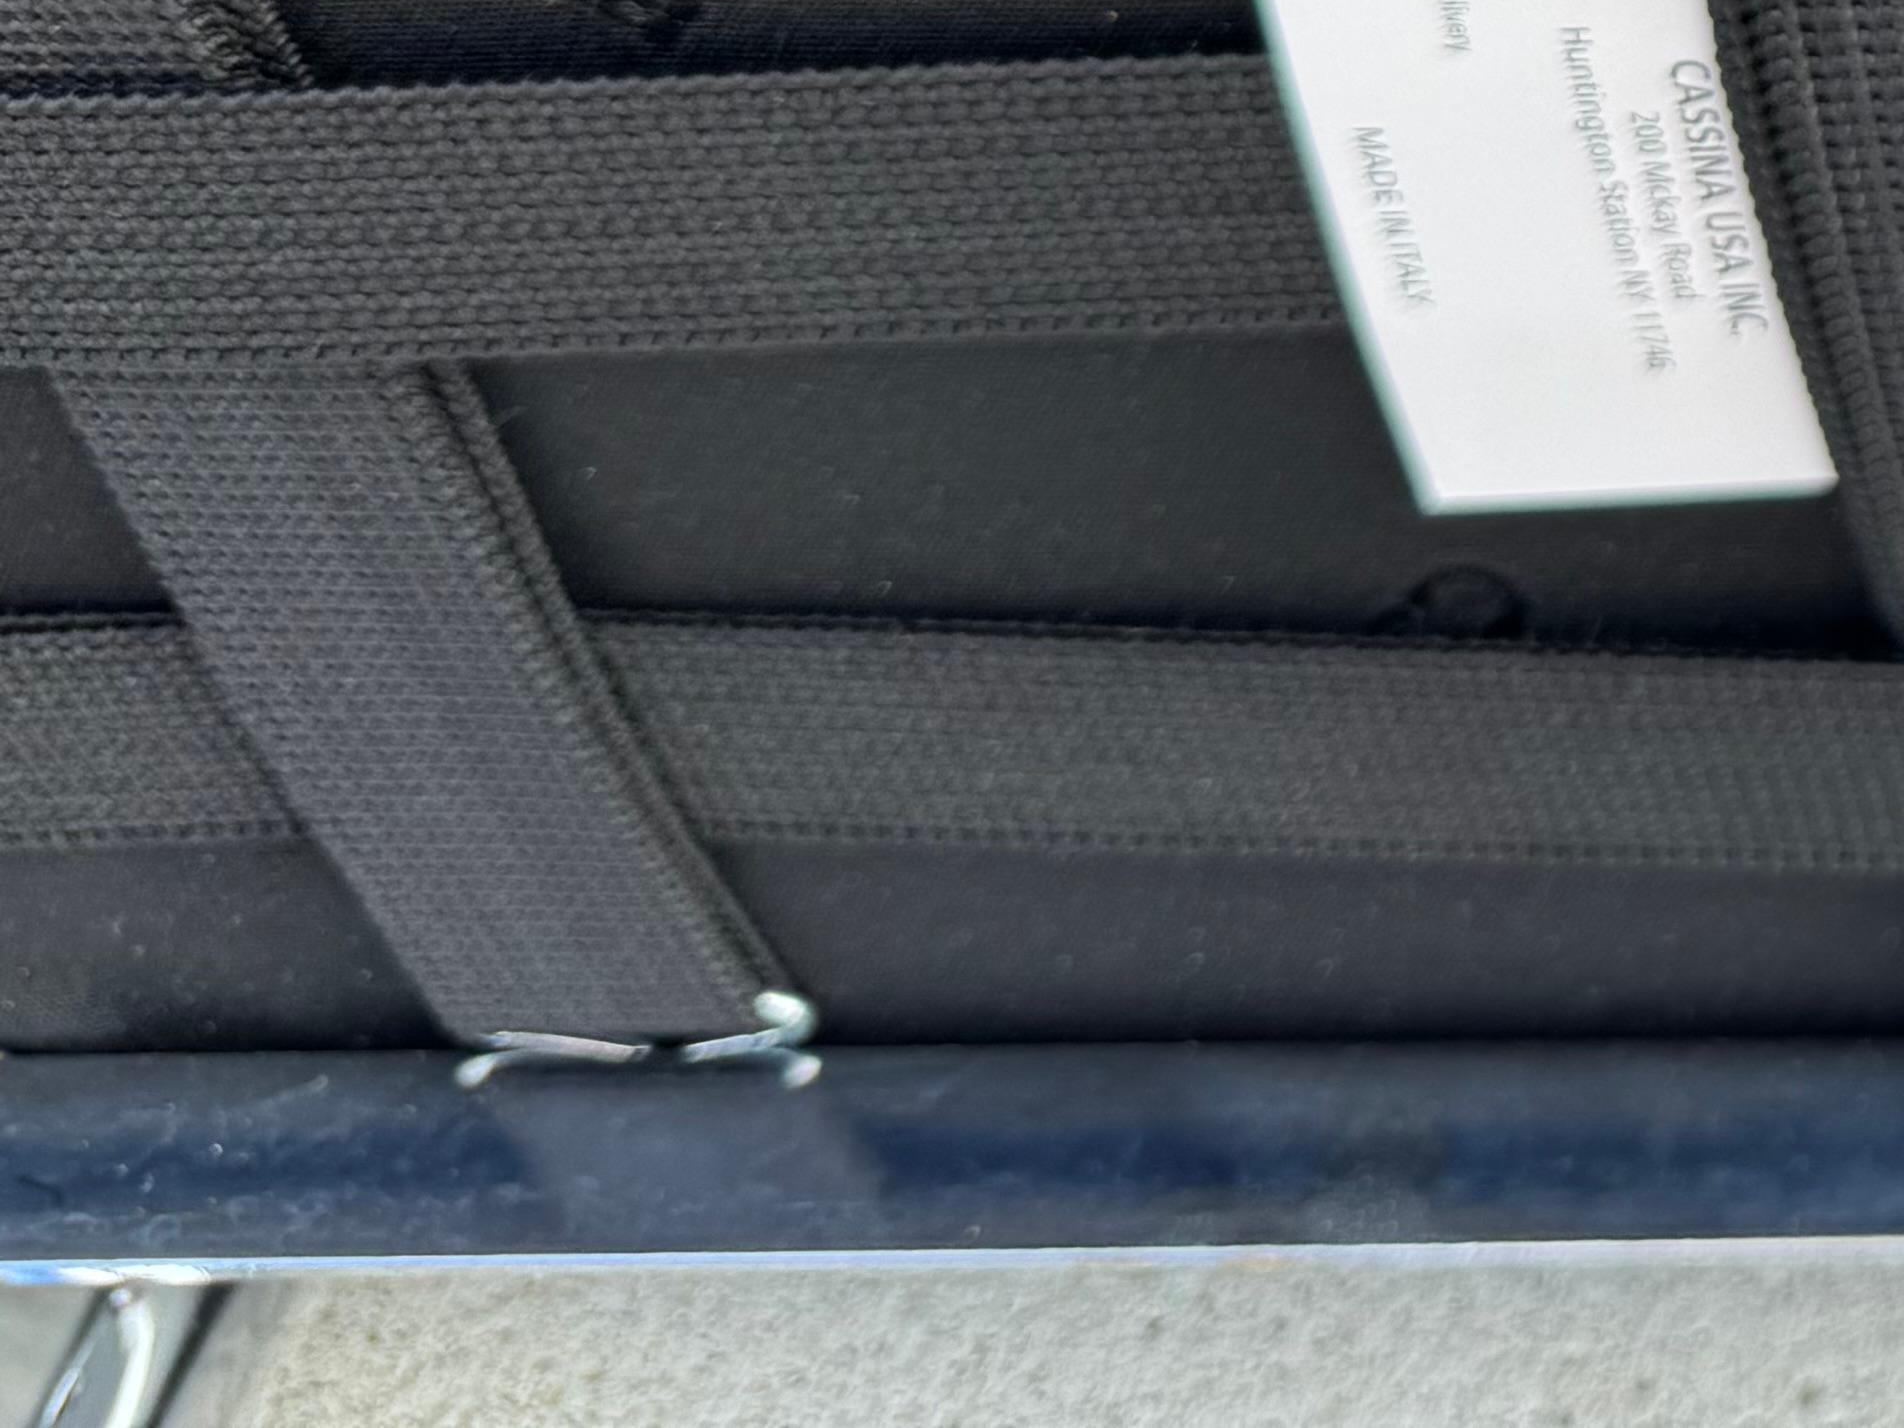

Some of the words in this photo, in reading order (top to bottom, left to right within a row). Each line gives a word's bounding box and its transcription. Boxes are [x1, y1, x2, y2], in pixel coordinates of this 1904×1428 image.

[1560, 26, 1616, 174] Huntington
[1669, 60, 1735, 200] CASSINA
[1354, 126, 1405, 205] MADE
[1382, 209, 1412, 239] IN
[1599, 181, 1643, 265] Station
[1631, 111, 1665, 154] 200
[1664, 243, 1700, 300] Road
[1387, 240, 1433, 307] ITALY
[1706, 211, 1749, 273] USA
[1623, 270, 1655, 304] NY
[1725, 282, 1769, 337] INC.
[1632, 310, 1674, 370] 11746
